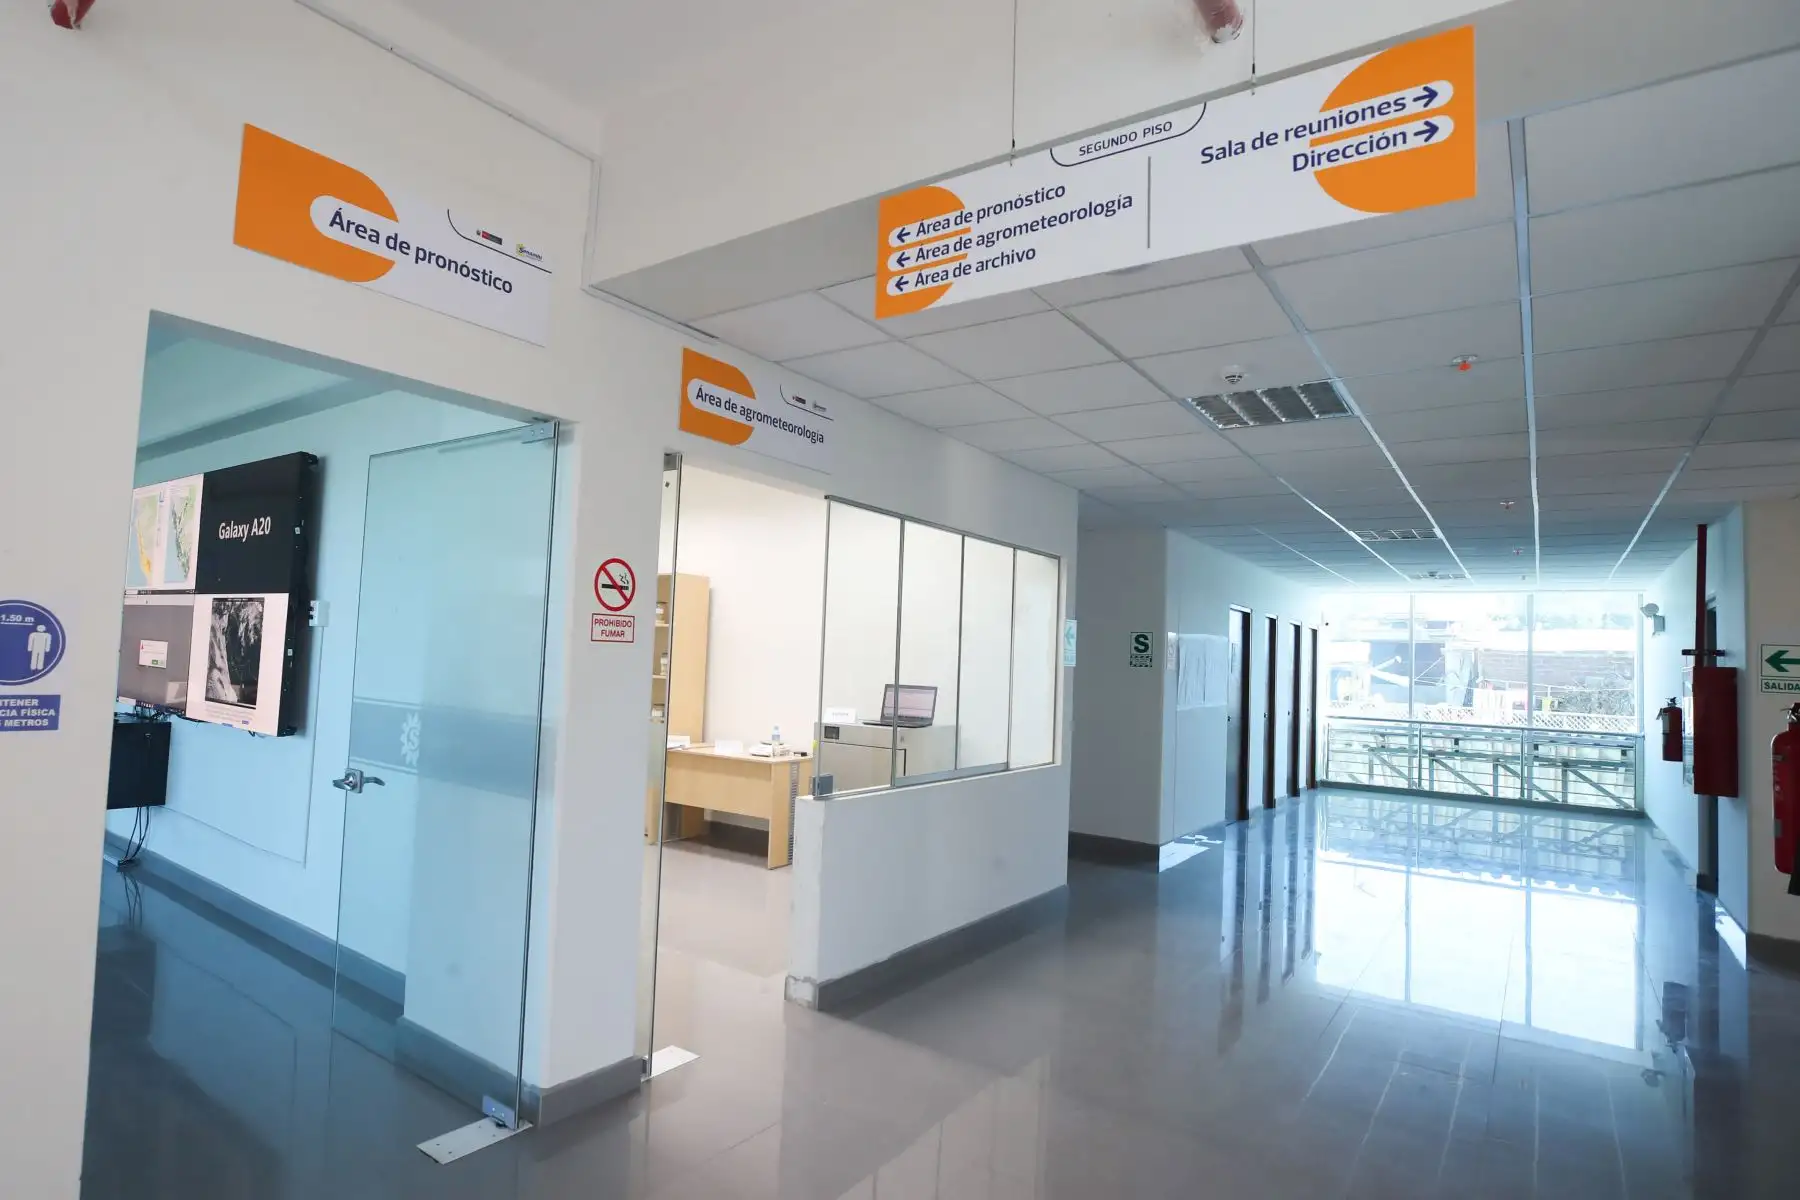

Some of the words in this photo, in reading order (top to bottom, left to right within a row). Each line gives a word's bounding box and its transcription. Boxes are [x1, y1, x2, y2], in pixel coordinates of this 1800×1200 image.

[1079, 132, 1138, 156] SEGUNDO
[1143, 121, 1173, 138] PISO
[1200, 140, 1246, 164] Sala
[1251, 131, 1278, 151] de
[1284, 96, 1407, 141] reuniones
[1292, 129, 1407, 172] Dirección
[916, 218, 951, 237] Área
[954, 209, 973, 227] de
[976, 184, 1066, 223] pronóstico
[915, 243, 950, 262] Área
[953, 235, 972, 253] de
[976, 194, 1133, 248] agrometeorología
[329, 207, 380, 244] Área
[386, 233, 410, 255] de
[415, 247, 513, 294] pronóstico
[914, 268, 949, 287] Área
[953, 260, 972, 278] de
[975, 247, 1036, 273] archivo
[696, 384, 722, 409] Área
[724, 397, 737, 413] de
[218, 520, 249, 542] Galaxy
[250, 516, 271, 536] A20
[0, 614, 22, 622] 1.50
[594, 618, 633, 628] PROHIBIDO
[600, 629, 625, 638] FUMAR
[1134, 634, 1150, 653] S
[1763, 681, 1800, 692] SALIDA
[4, 719, 49, 727] METROS
